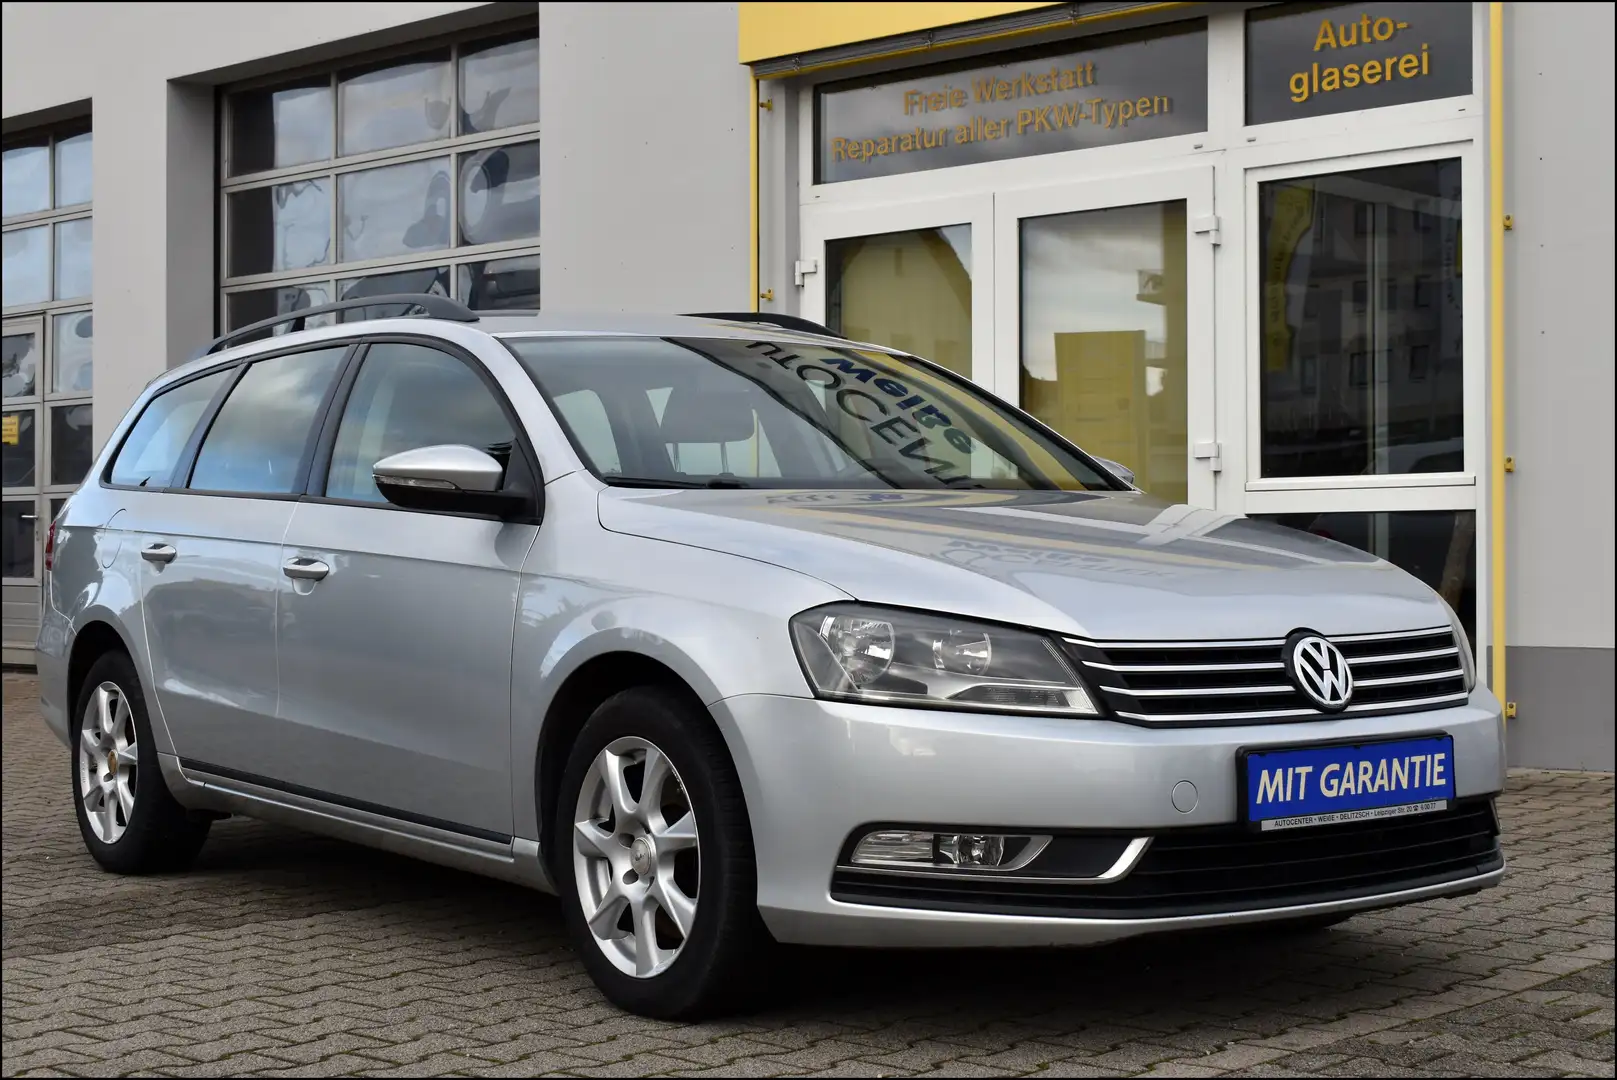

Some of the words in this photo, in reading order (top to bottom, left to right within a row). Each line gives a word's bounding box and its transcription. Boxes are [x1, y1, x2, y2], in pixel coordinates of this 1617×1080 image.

[1313, 13, 1409, 51] Auto-
[903, 84, 966, 116] Freie
[971, 60, 1095, 103] Werkstatt
[1289, 43, 1429, 102] glaserei
[831, 126, 949, 163] Reparatur
[955, 115, 1011, 144] aller
[1016, 95, 1170, 135] PKW-Typen
[1293, 636, 1353, 705] VW
[1255, 765, 1313, 805] MIT
[1319, 752, 1447, 798] GARANTIE
[1274, 816, 1314, 827] AUTOCENTER
[1340, 811, 1370, 820] DELITZSCH
[1374, 807, 1397, 817] Leipziger
